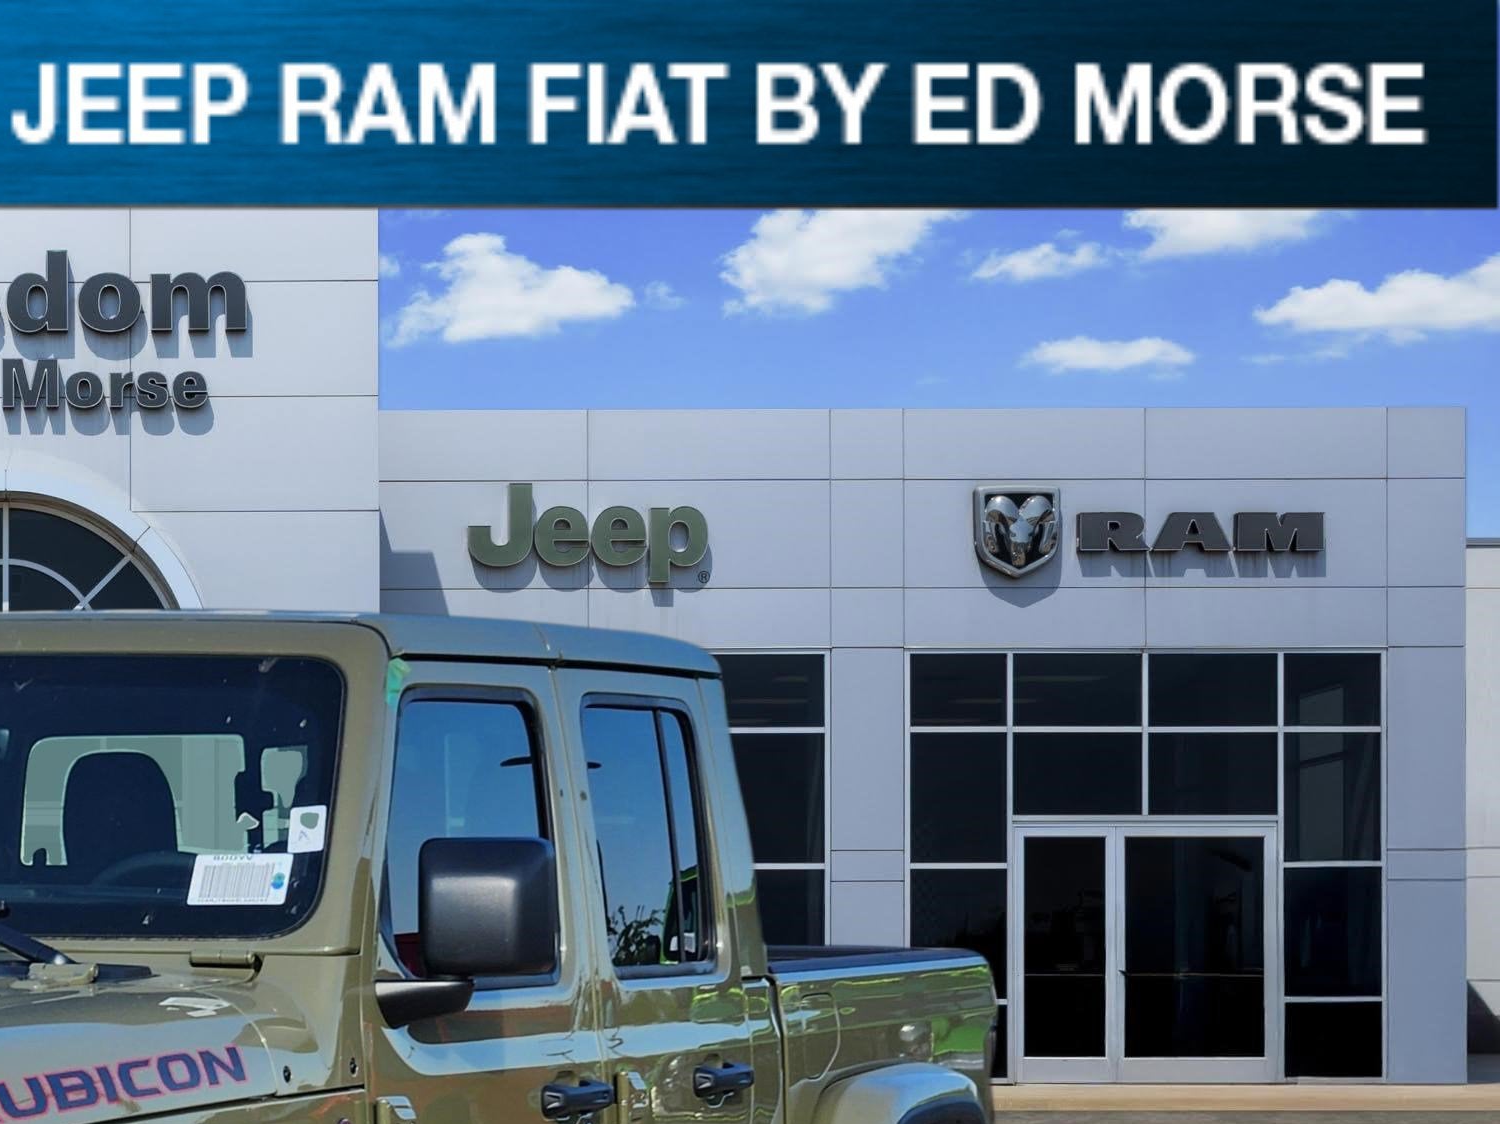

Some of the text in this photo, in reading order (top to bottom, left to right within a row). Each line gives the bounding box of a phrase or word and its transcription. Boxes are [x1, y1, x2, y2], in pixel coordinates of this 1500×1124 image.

[2, 359, 208, 410] Morse
[467, 483, 709, 584] Jeep
[1076, 511, 1326, 553] RAM
